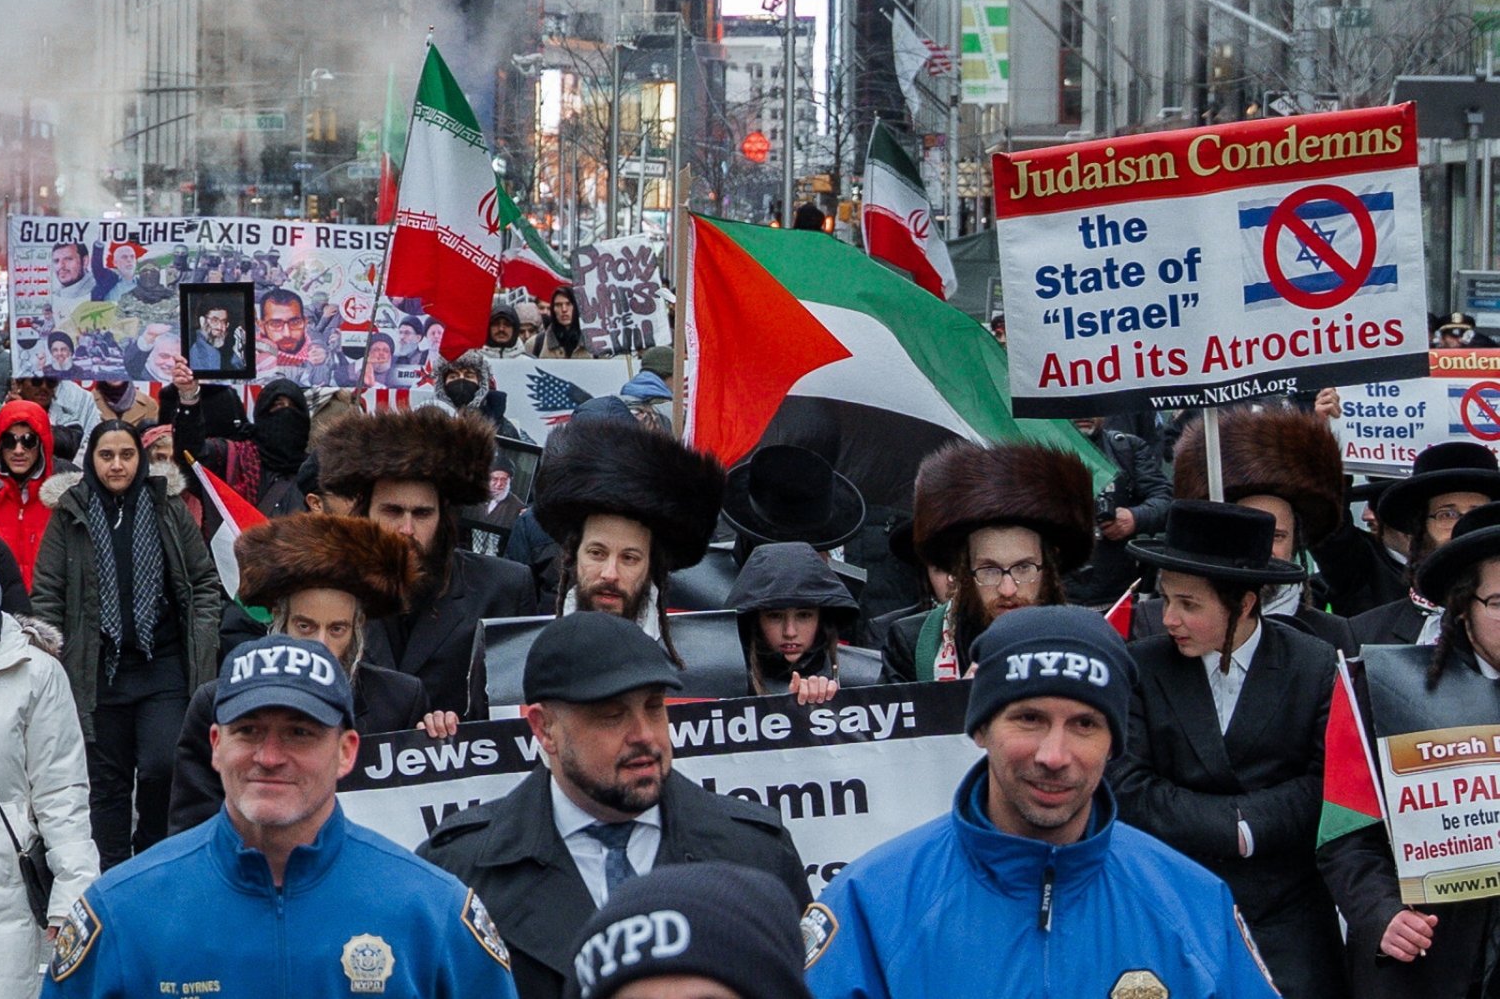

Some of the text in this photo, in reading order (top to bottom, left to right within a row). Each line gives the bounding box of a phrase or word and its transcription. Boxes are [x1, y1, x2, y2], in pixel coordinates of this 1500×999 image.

[1010, 125, 1403, 200] Judaism Condemns
[20, 221, 90, 244] GLORY
[99, 222, 128, 242] TO
[138, 222, 186, 243] THE
[196, 220, 262, 245] AXIS
[272, 225, 304, 247] OF
[1078, 215, 1148, 250] the
[1035, 247, 1201, 300] State of
[1042, 293, 1200, 340] “Israel”
[1038, 313, 1405, 388] And its Atrocities
[1150, 377, 1298, 408] www.NKUSA.org
[1366, 383, 1400, 397] the
[1342, 401, 1426, 418] State of
[1346, 442, 1417, 460] And its
[230, 645, 336, 686] NYPD
[1005, 652, 1110, 687] NYPD
[364, 738, 499, 781] Jews
[808, 700, 917, 740] say:
[1416, 737, 1487, 761] Torah
[1398, 782, 1449, 814] ALL
[1442, 814, 1460, 831] be
[1403, 834, 1493, 862] Palestinian
[574, 909, 691, 999] NYPD
[160, 980, 221, 995] DET. BYRNES
